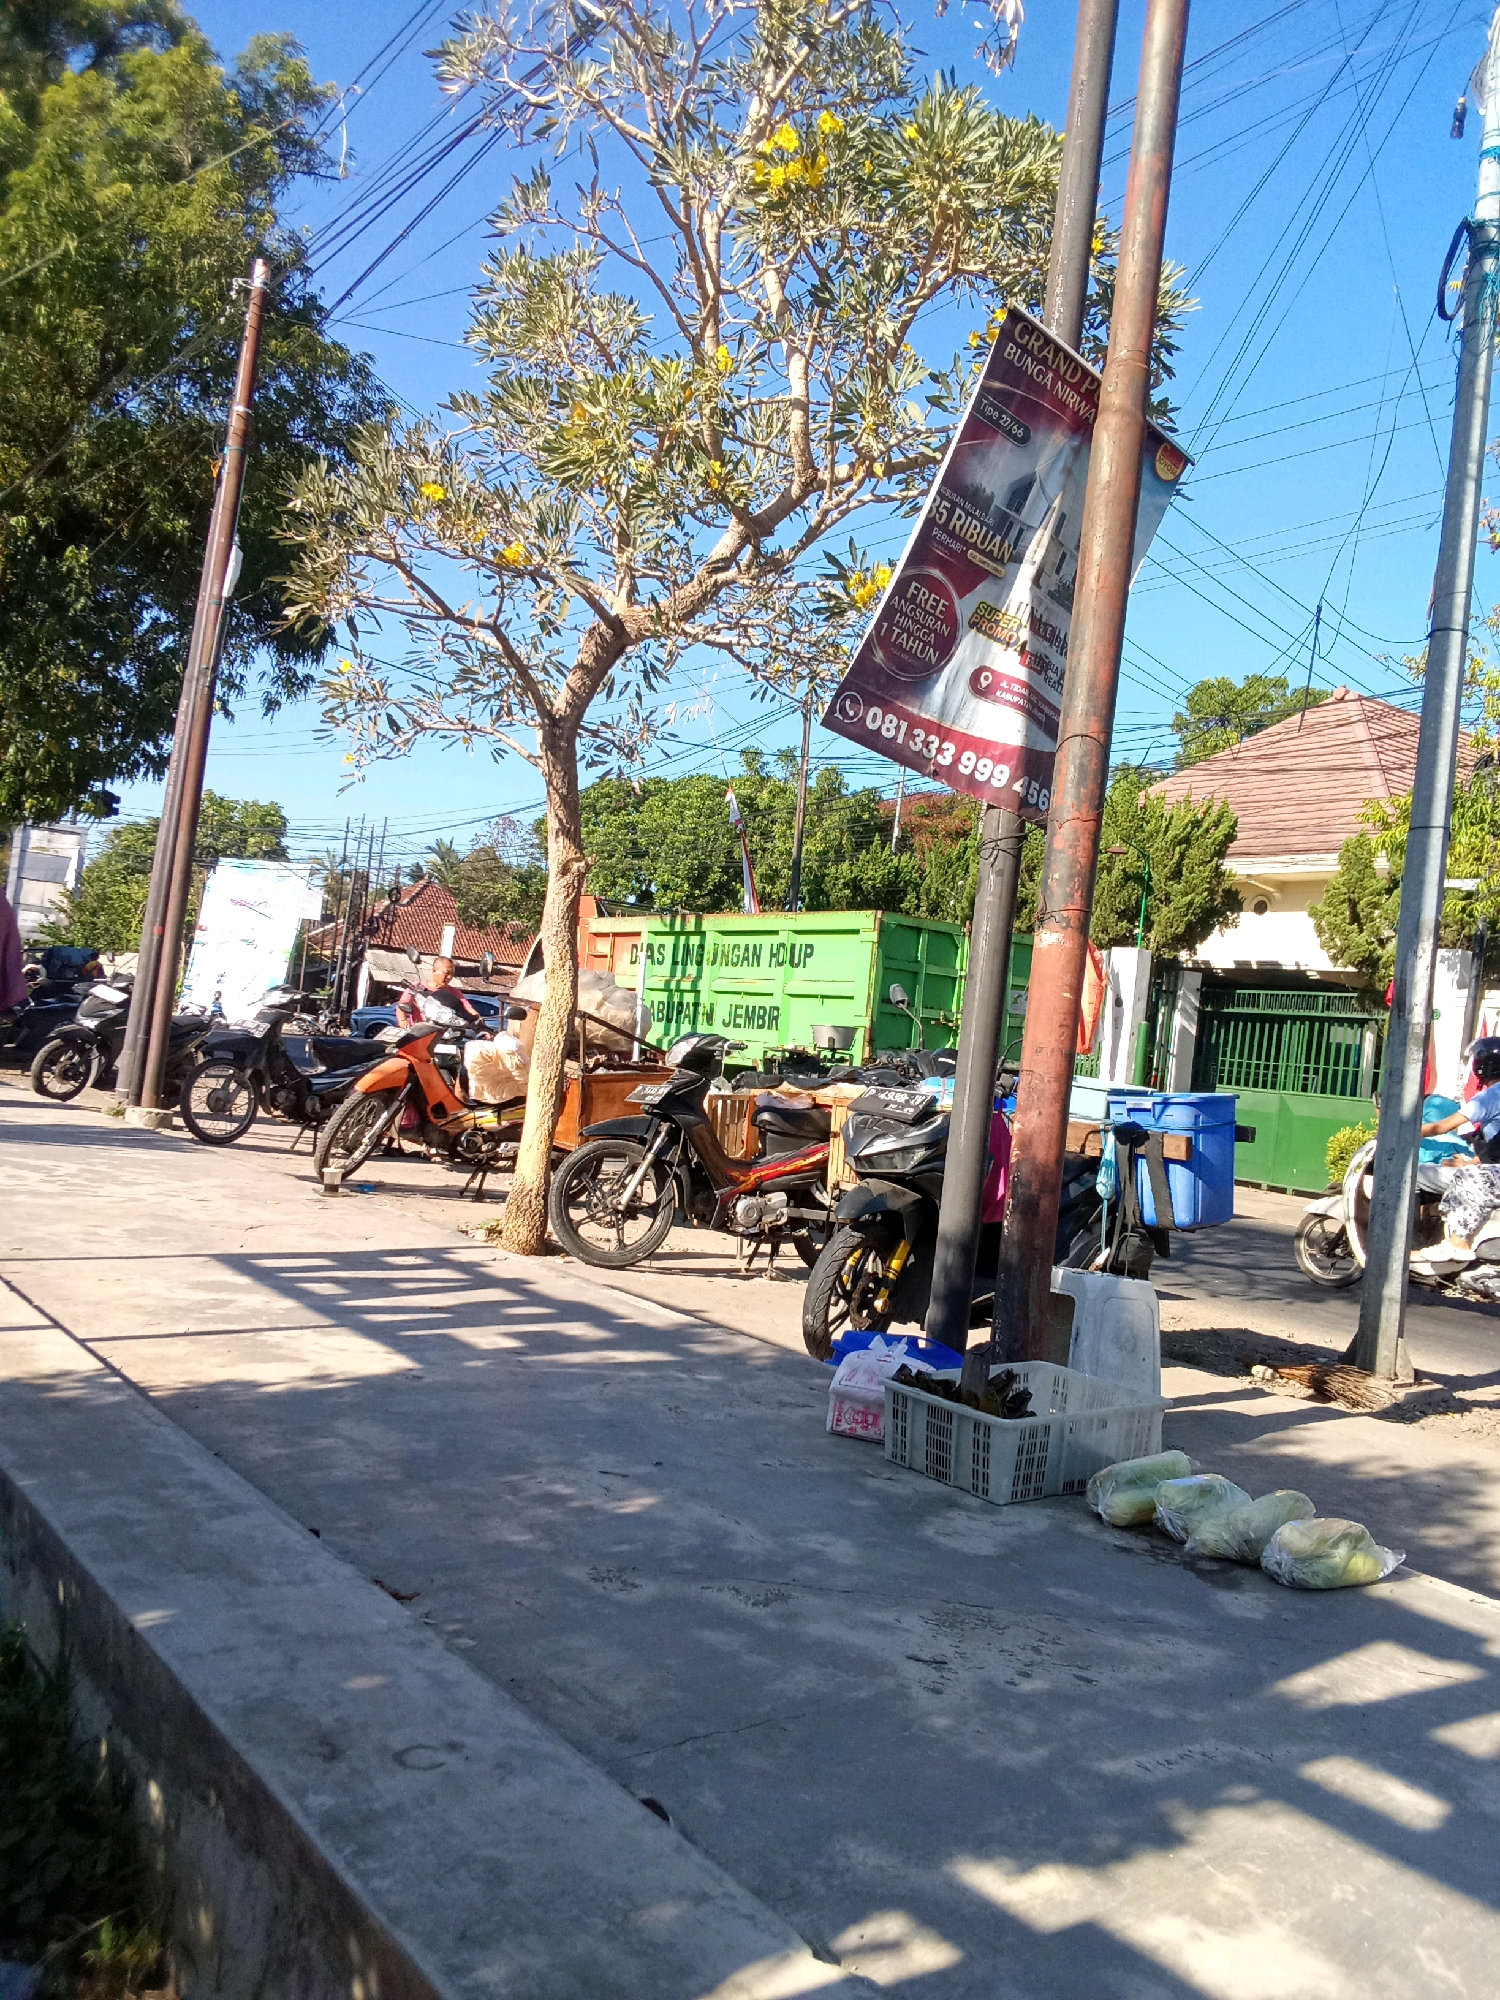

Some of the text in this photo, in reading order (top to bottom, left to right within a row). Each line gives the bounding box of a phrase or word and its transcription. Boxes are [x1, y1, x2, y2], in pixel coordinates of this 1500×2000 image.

[1015, 321, 1082, 383] GRAND
[1003, 342, 1097, 424] BUNGA NIRWA
[980, 398, 1024, 438] Tipe 27/66
[948, 507, 1013, 564] RIBUAN
[889, 595, 951, 638] ANGSURAN
[906, 581, 949, 619] FREE
[976, 602, 1021, 631] SUPER
[880, 622, 889, 637] 1
[890, 626, 939, 665] TAHUN
[894, 612, 935, 646] HINGGA
[970, 613, 1018, 643] PROMO
[865, 706, 1050, 812] 081 333 999 456
[630, 942, 666, 965] DAS
